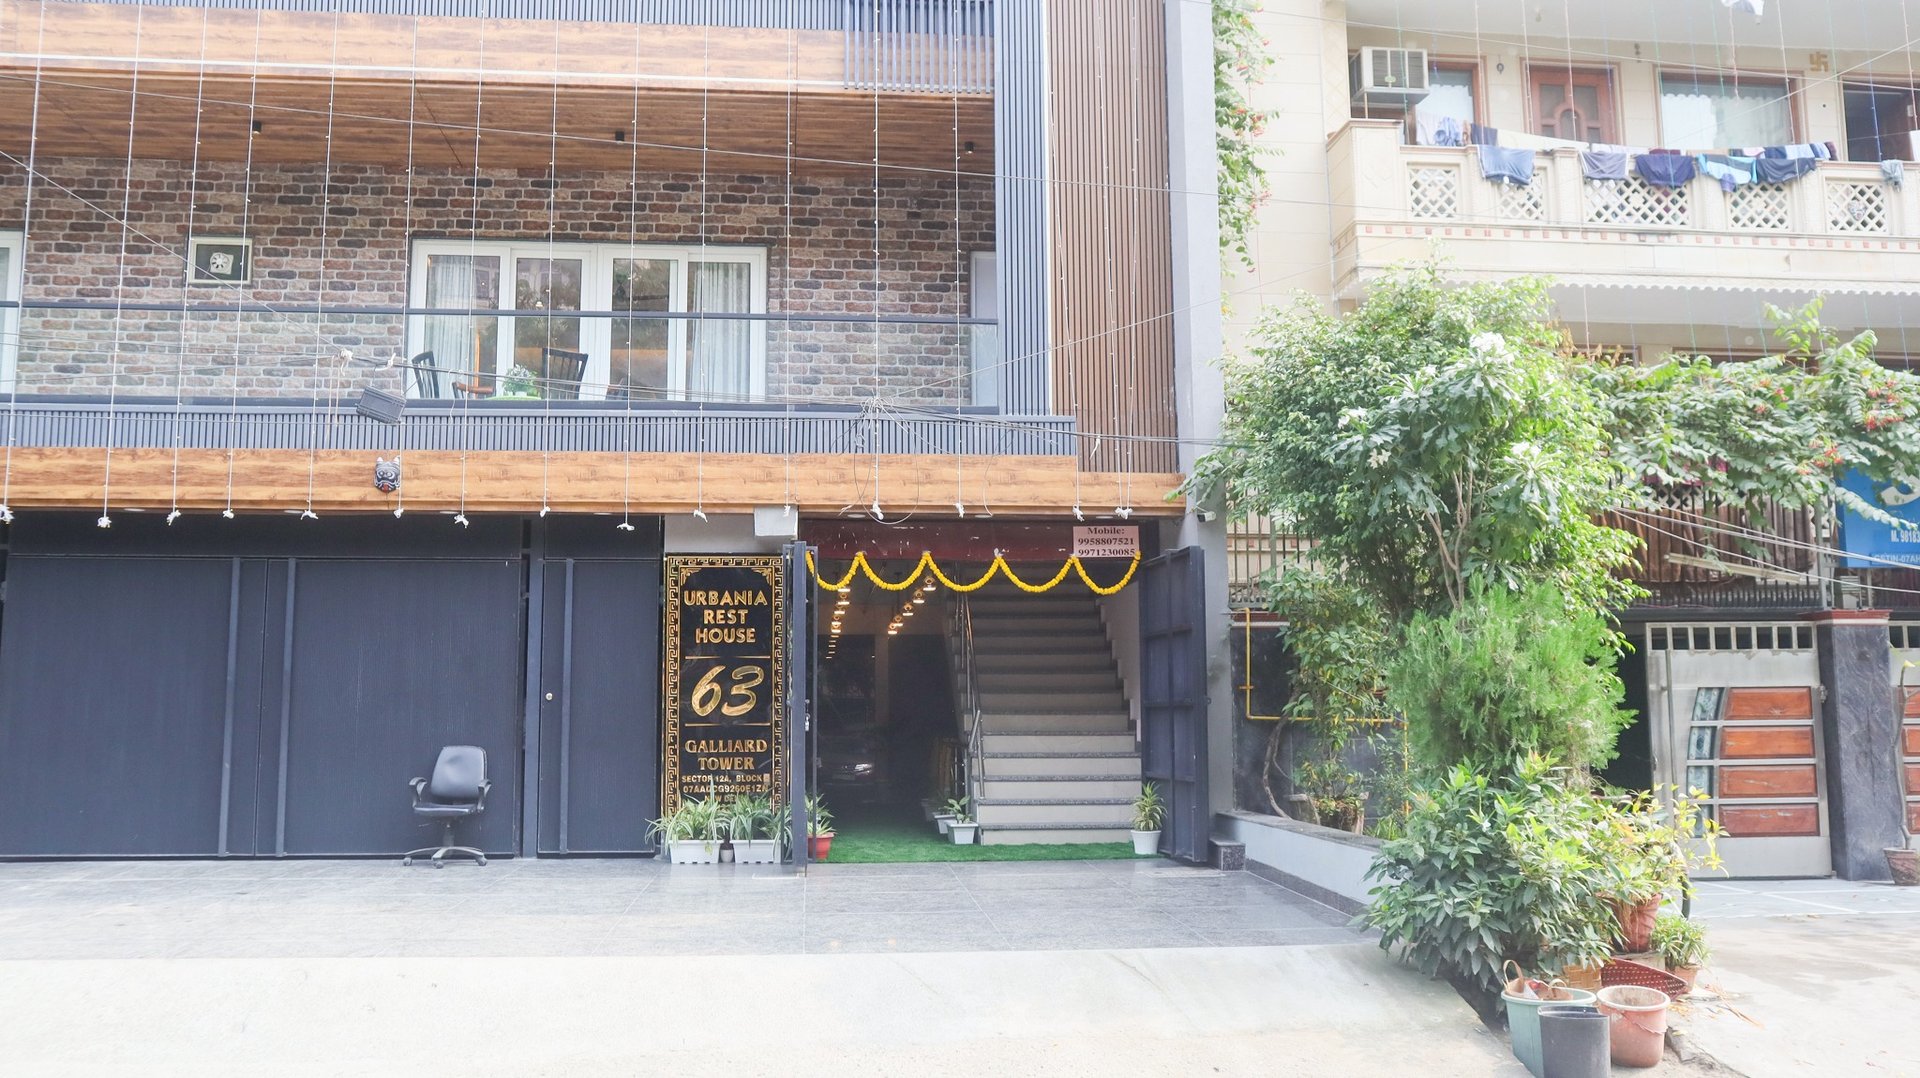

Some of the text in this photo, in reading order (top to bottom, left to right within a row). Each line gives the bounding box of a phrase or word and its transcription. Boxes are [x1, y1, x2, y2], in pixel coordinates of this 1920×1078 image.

[684, 590, 768, 606] URBANIA
[704, 609, 748, 624] REST
[695, 628, 756, 644] HOUSE
[691, 665, 765, 717] 63
[684, 740, 768, 753] GALLIARD
[698, 757, 755, 770] TOWER
[682, 774, 712, 782] SECTOR
